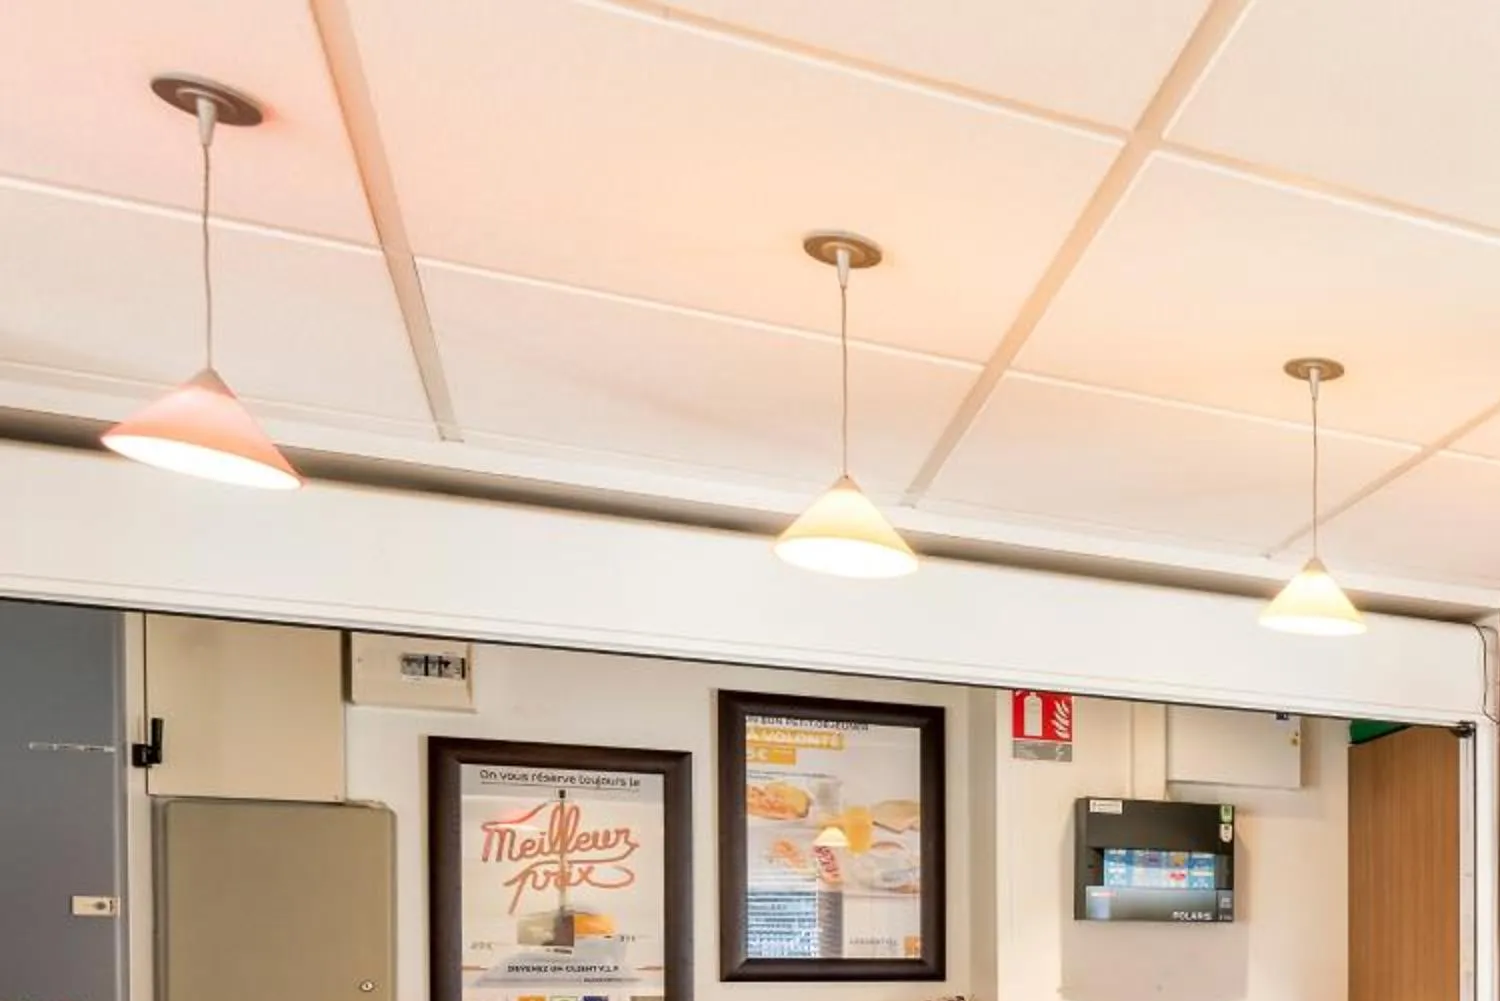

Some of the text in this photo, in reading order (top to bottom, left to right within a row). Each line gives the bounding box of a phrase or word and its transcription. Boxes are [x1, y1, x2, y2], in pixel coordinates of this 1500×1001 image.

[479, 768, 497, 780] On
[501, 771, 529, 782] vous
[532, 772, 577, 785] réserve
[578, 774, 627, 790] toujours
[481, 801, 640, 863] Meilleur
[503, 860, 635, 915] prix
